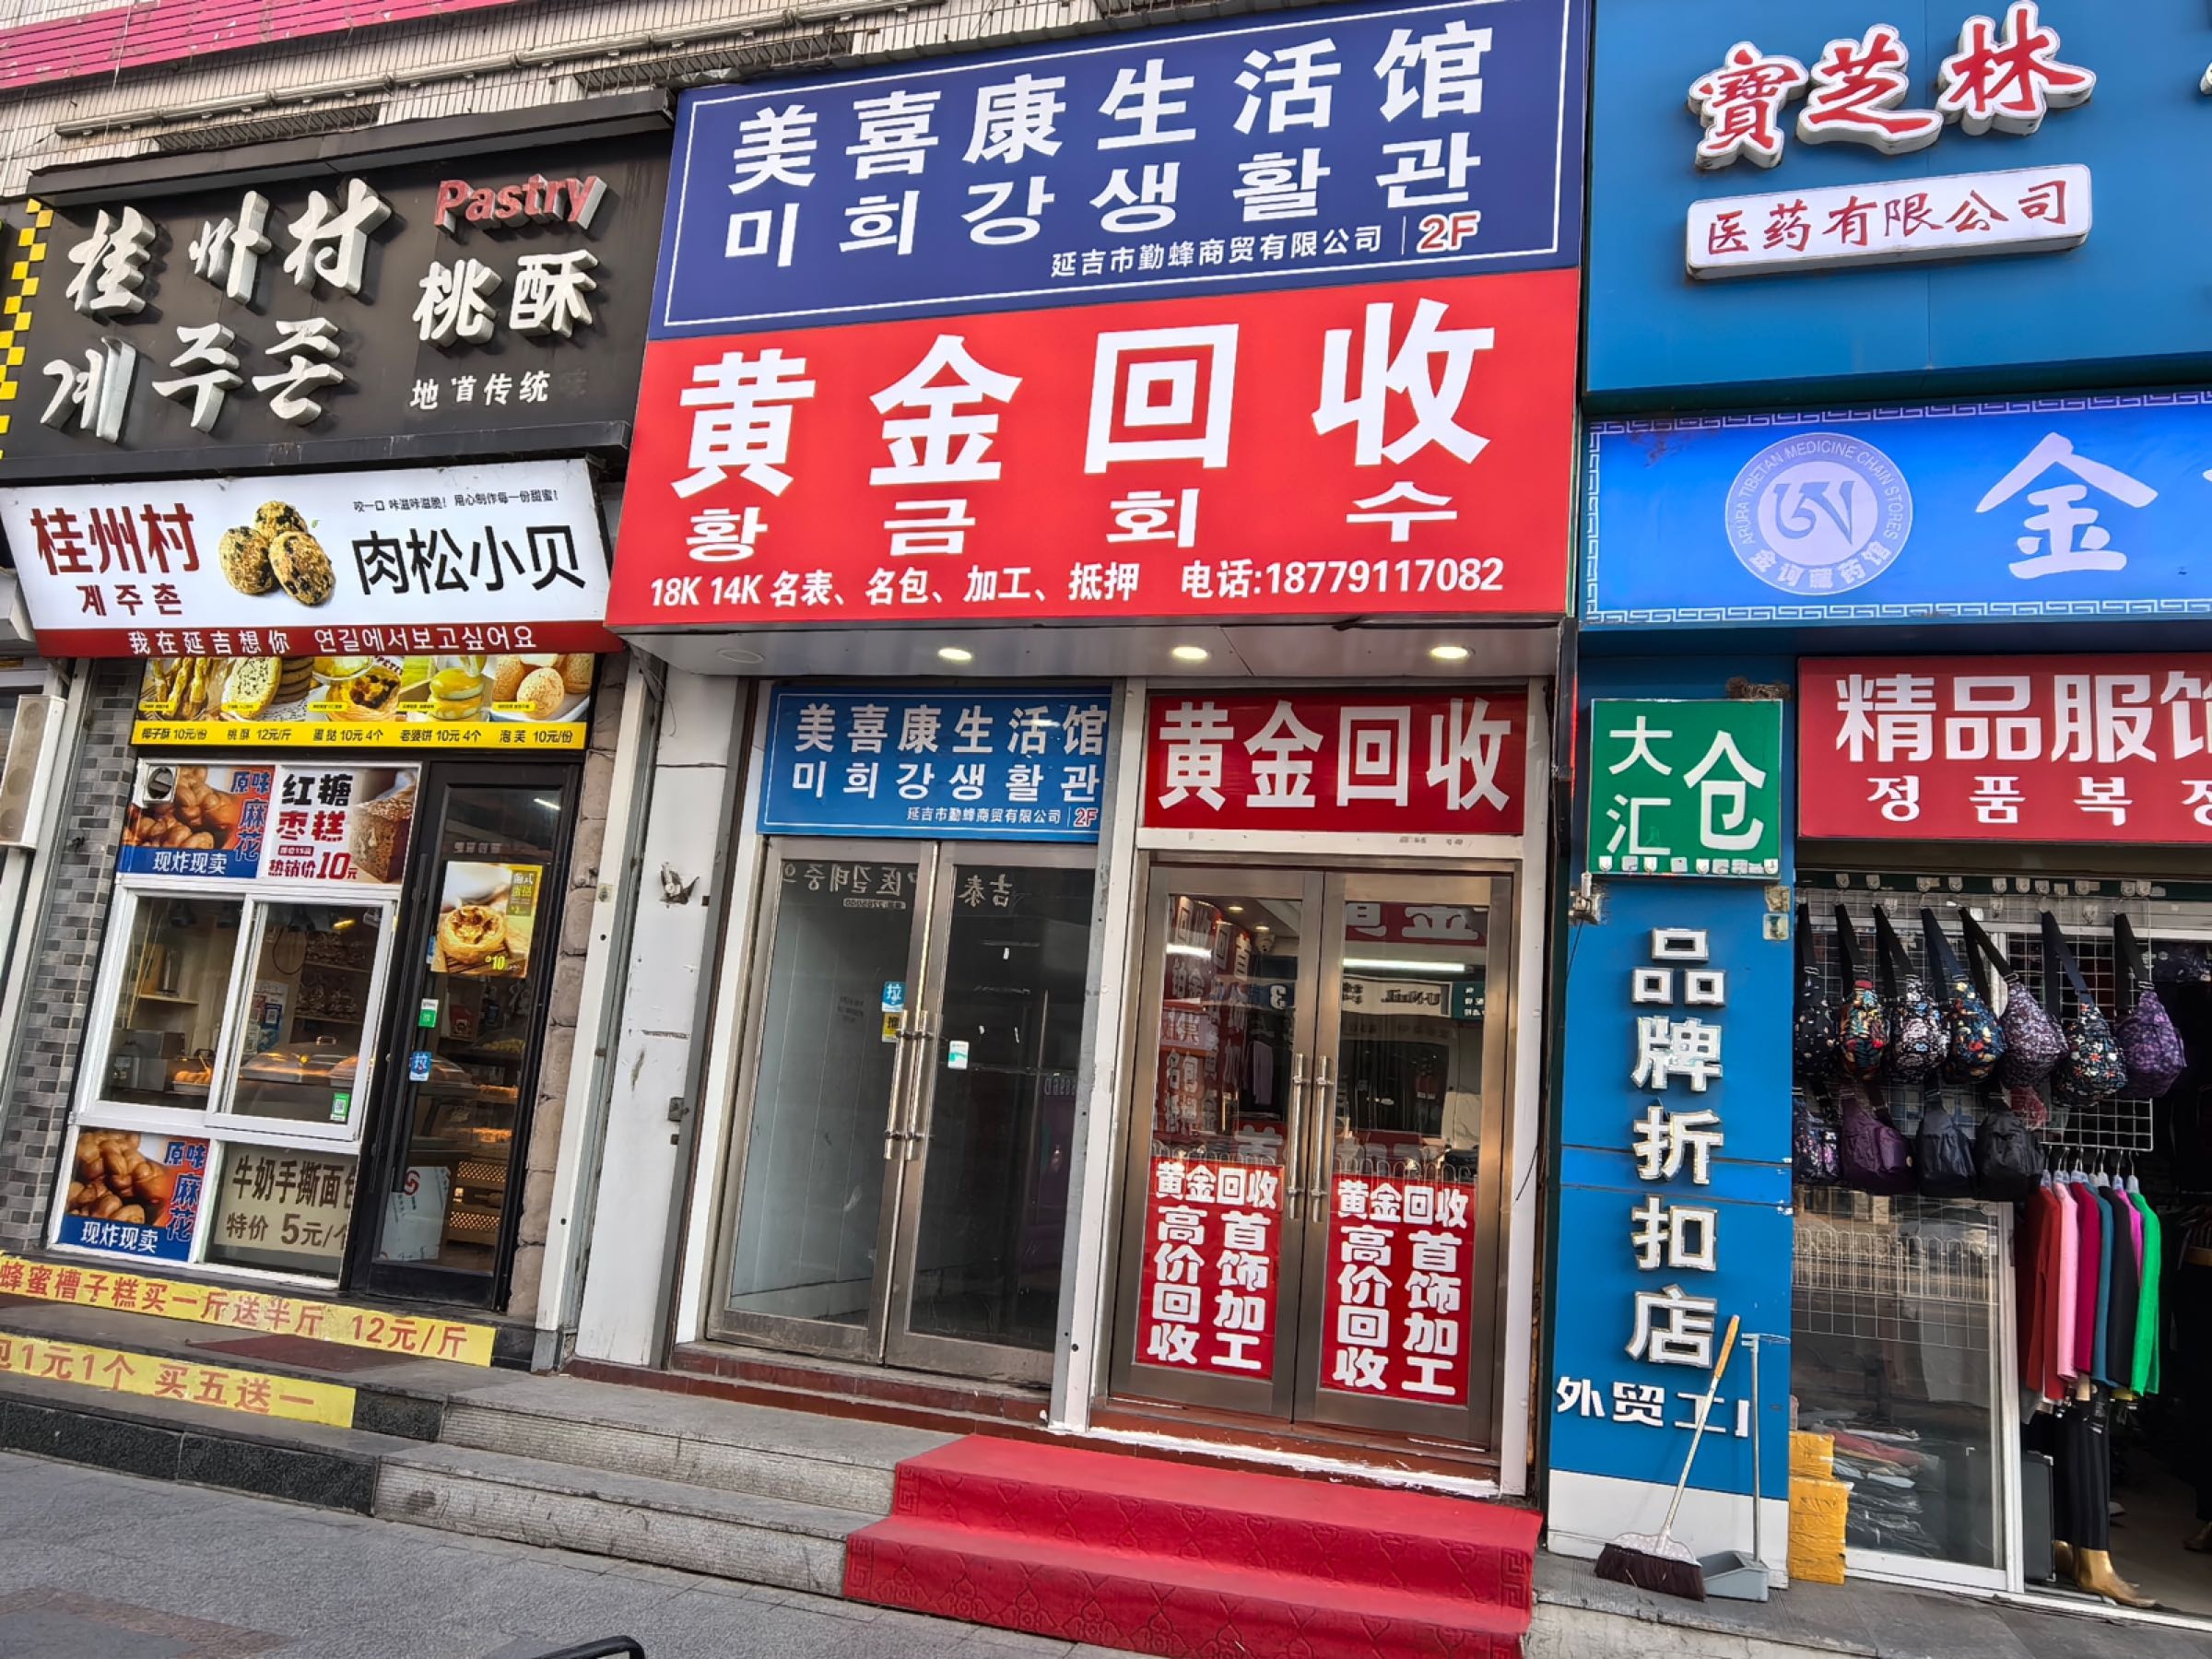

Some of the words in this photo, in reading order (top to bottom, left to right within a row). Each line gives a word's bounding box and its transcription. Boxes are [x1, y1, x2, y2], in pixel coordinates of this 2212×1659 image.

[728, 19, 1493, 196] 美喜康生活馆
[1688, 0, 2097, 170] 寶芝林
[434, 173, 606, 232] Pastry
[724, 132, 1481, 268] 미희강생활관
[1707, 179, 2066, 257] 医药有限公司
[65, 178, 392, 314] 桂州村
[1051, 224, 1382, 278] 延吉市勤蜂商贸有限公司
[1417, 210, 1482, 254] 2F
[412, 249, 599, 347] 桃酥
[671, 298, 1495, 500] 黄金回收
[686, 480, 1458, 562] 황금회수
[1784, 440, 1858, 461] MEDICINE
[1856, 451, 1895, 486] CHAIN
[1883, 485, 1905, 541] STORES
[1975, 431, 2212, 579] 金
[29, 502, 200, 576] 桂州村
[351, 524, 586, 595] 肉松小贝
[76, 582, 182, 617] 계주촌
[650, 575, 700, 606] 18K
[711, 573, 763, 605] 14K
[128, 629, 290, 656] 我在延吉想你
[313, 625, 537, 654] 연길에서보고싶어요
[794, 703, 1107, 757] 美喜康生活馆
[1158, 697, 1512, 811] 黄金回收
[229, 770, 272, 795] 原味
[281, 773, 354, 806] 红糖
[791, 759, 1100, 803] 미희강생활관
[234, 797, 270, 863] 麻花
[276, 810, 346, 842] 枣糕
[906, 806, 1061, 825] 延吉市勤蜂商贸有限公司
[1074, 806, 1099, 828] 2F
[152, 851, 228, 876] 现炸现卖
[164, 1141, 206, 1169] 原味
[1625, 926, 1726, 1370] 品牌折扣店
[166, 1173, 203, 1242] 麻花
[1155, 1160, 1278, 1210] 黄金回收
[1336, 1179, 1469, 1230] 黄金回收
[80, 1220, 159, 1253] 现炸现卖
[226, 1211, 269, 1242] 特价
[1147, 1205, 1207, 1366] 高价回收
[1210, 1208, 1272, 1371] 首饰加工
[1332, 1224, 1394, 1392] 高价回收
[1401, 1230, 1463, 1397] 首饰加工
[352, 1314, 468, 1359] 12元/斤
[154, 1362, 315, 1414] 买五送一
[1556, 1375, 1750, 1439] 外贸工
